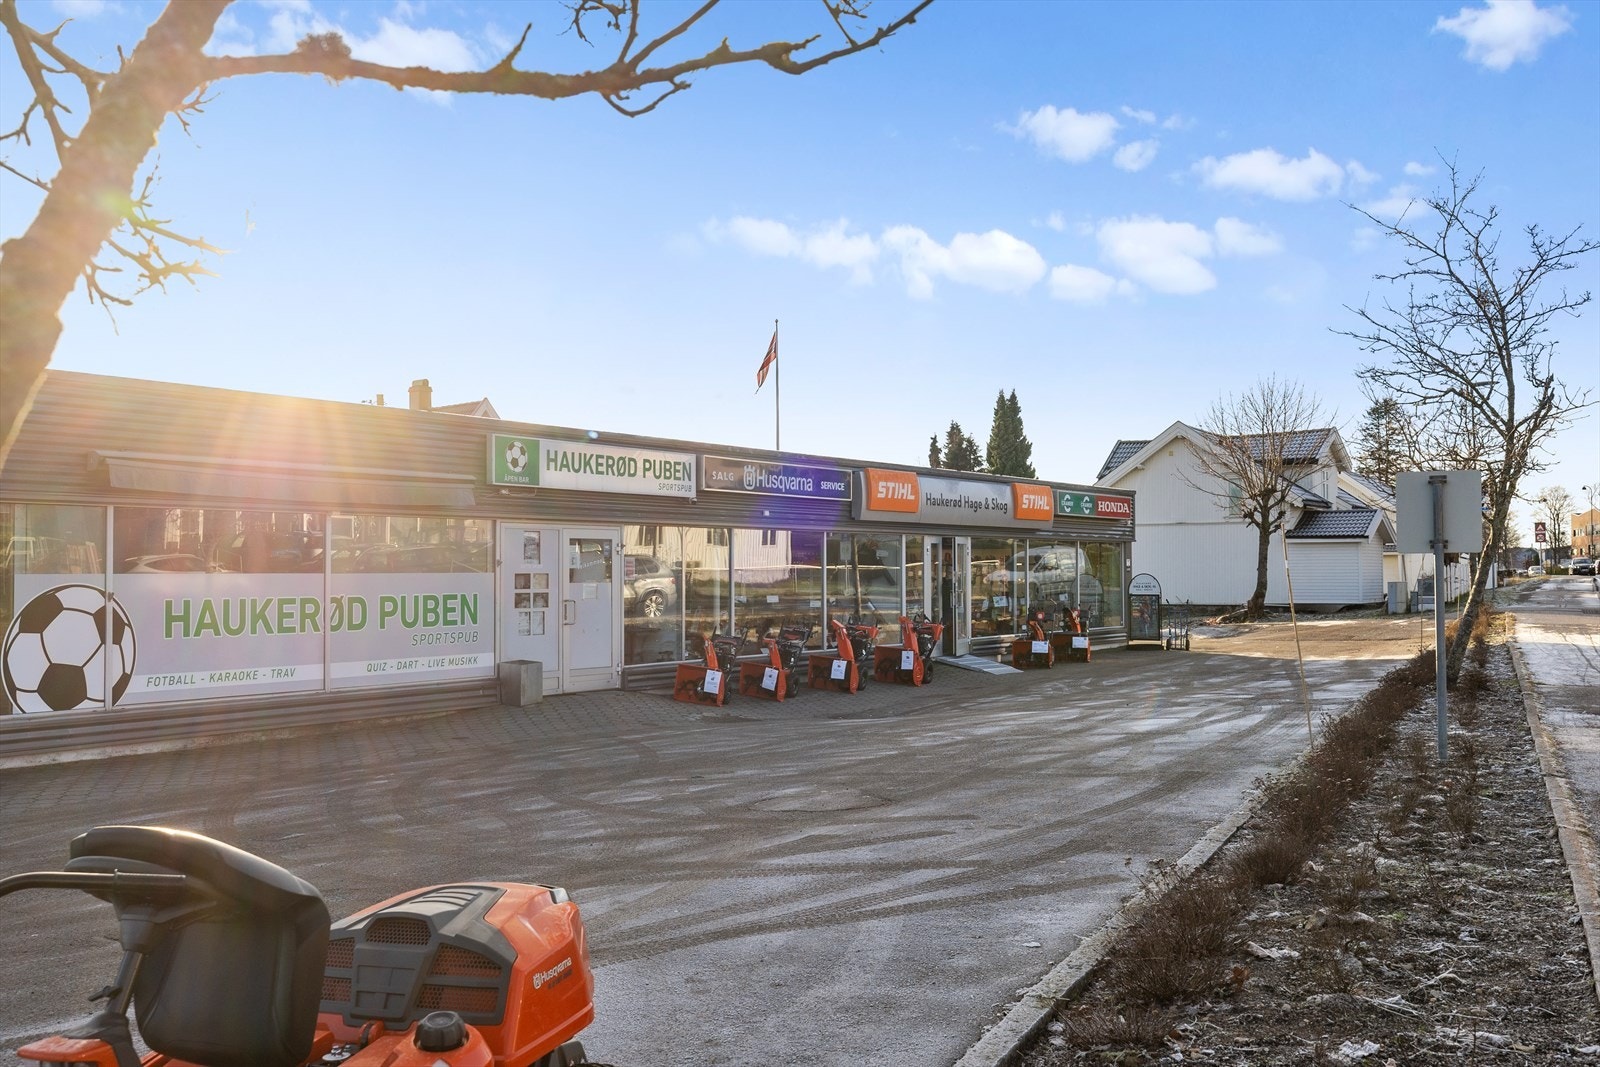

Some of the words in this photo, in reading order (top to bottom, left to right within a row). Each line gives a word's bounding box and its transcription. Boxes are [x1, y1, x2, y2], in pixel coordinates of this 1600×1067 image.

[546, 449, 637, 478] HAUKERØD
[642, 458, 692, 482] PUBEN
[504, 474, 519, 483] ÅPEN
[519, 476, 530, 484] BAR
[712, 471, 734, 481] SALG
[756, 469, 813, 492] Husqvarna
[658, 482, 692, 493] SPORTSPUB
[820, 481, 845, 491] SERVICE
[877, 481, 916, 500] STIHL
[925, 493, 962, 508] Haukerød
[963, 495, 983, 513] Hage
[984, 497, 990, 509] &
[991, 497, 1008, 515] Skog
[1021, 494, 1050, 510] STIHL
[1097, 501, 1130, 513] HONDA
[164, 596, 368, 639] HAUKERØD
[378, 593, 479, 630] PUBEN
[411, 631, 479, 646] SPORTSPUB
[366, 662, 387, 673] QUIZ
[396, 660, 419, 670] DART
[427, 658, 445, 668] LIVE
[448, 656, 478, 666] MUSIKK
[146, 674, 196, 687] FOTBALL
[209, 670, 259, 683] KARAOKE
[271, 668, 296, 679] TRAV
[541, 957, 572, 983] Husqvarna
